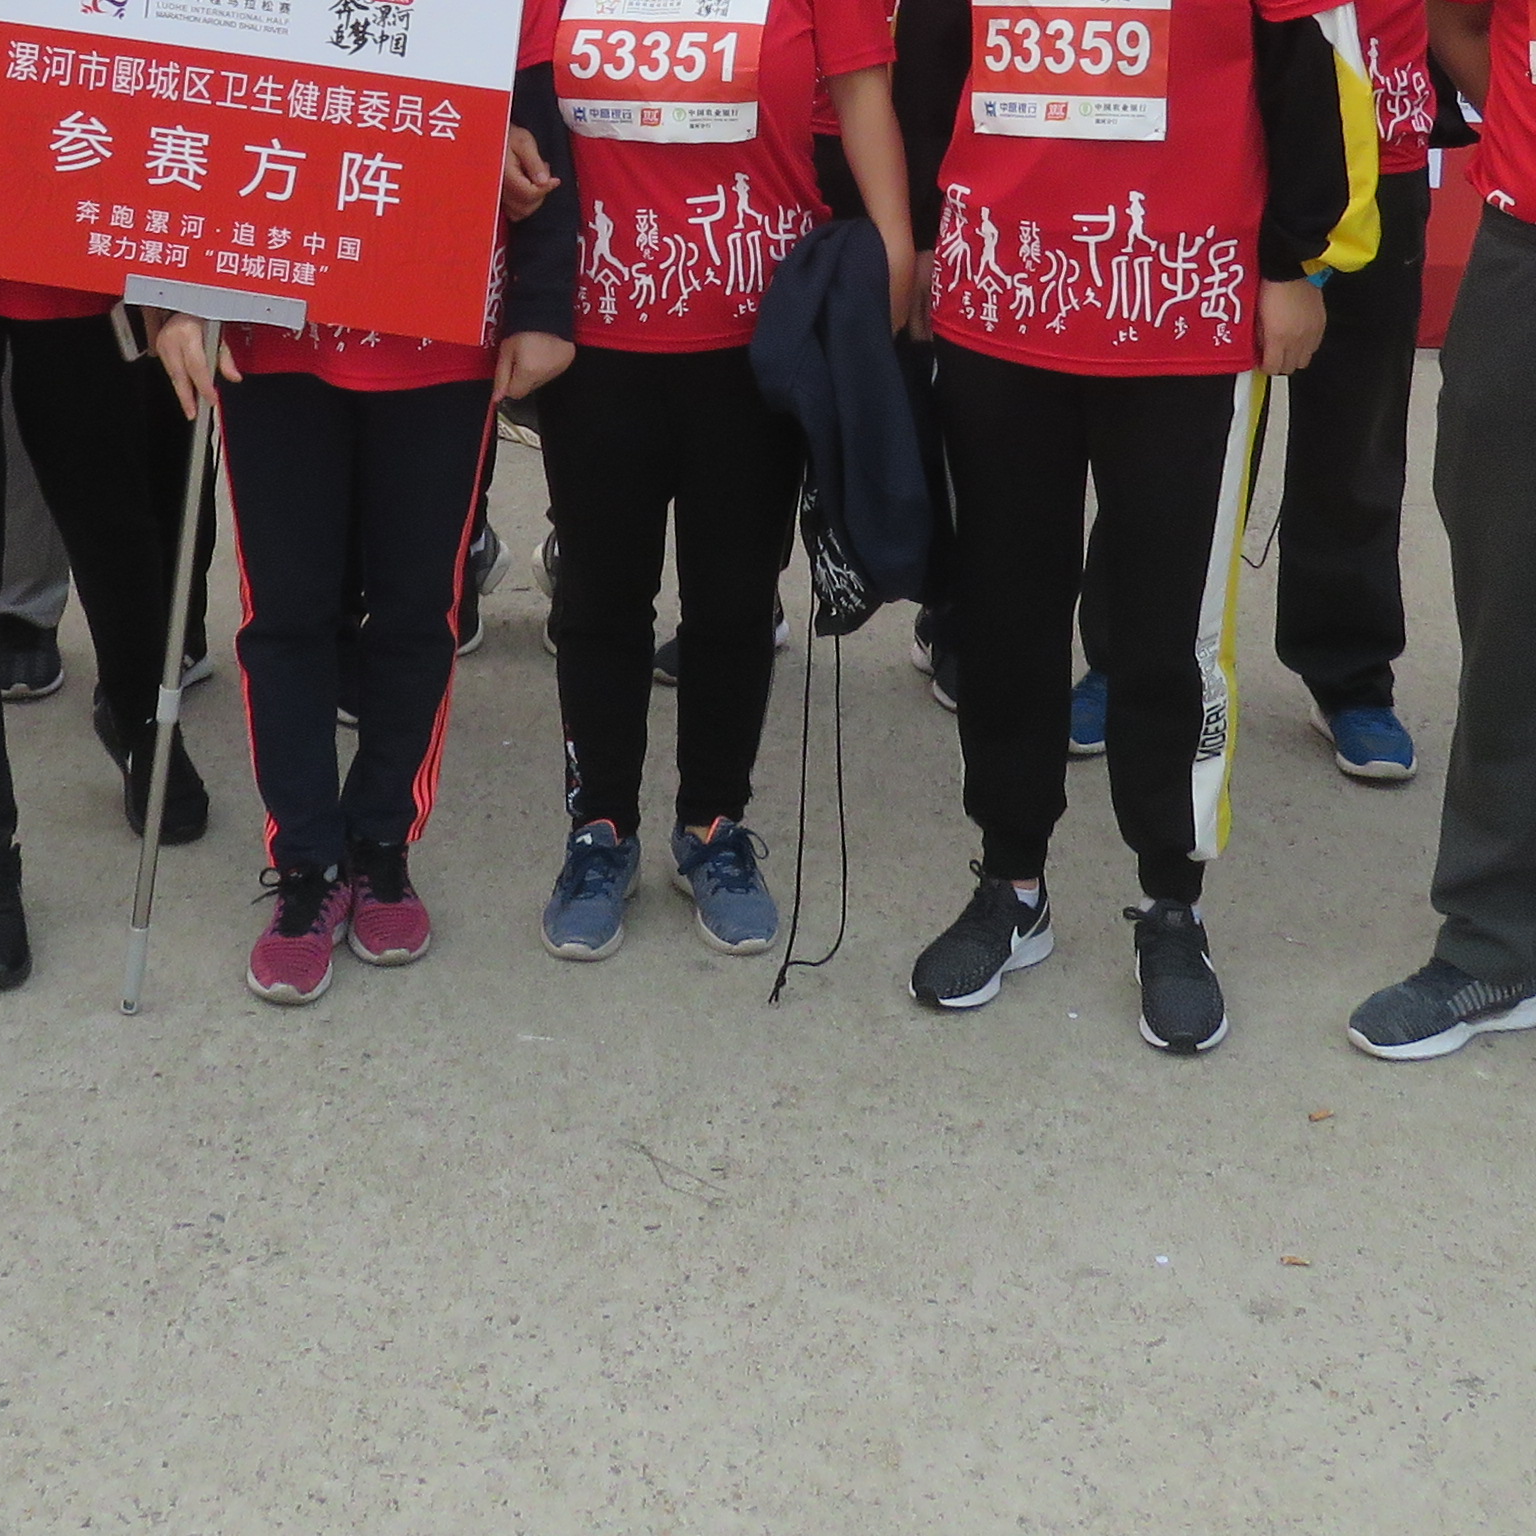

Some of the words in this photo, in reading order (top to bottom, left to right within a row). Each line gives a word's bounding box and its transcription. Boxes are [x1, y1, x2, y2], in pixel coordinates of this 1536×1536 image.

[568, 28, 738, 83] 53351
[983, 17, 1151, 76] 53359
[5, 39, 462, 142] 漯河市郾城区卫生健康委员会
[49, 110, 404, 217] 参赛方阵
[87, 231, 190, 268] 聚力漯河
